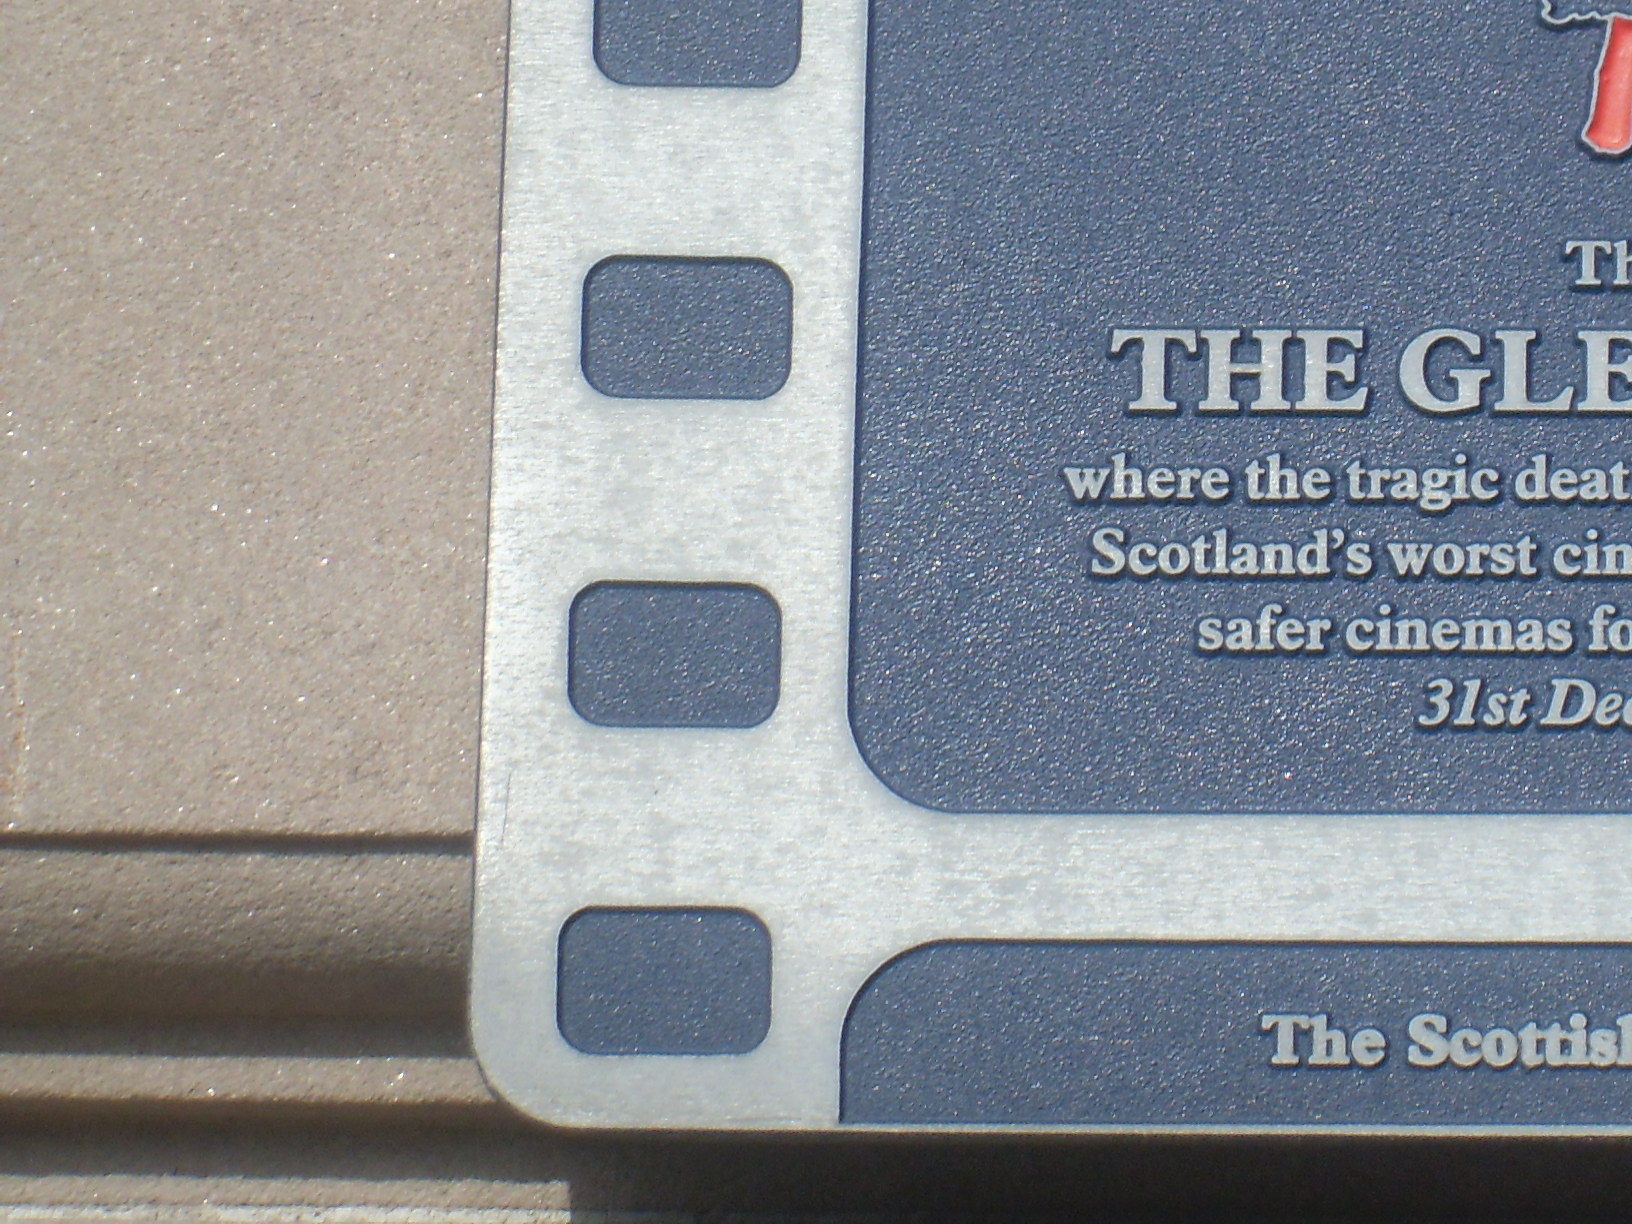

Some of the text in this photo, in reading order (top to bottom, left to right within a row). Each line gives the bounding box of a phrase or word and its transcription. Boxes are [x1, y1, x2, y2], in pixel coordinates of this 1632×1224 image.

[1110, 328, 1368, 413] THE
[1063, 452, 1231, 502] where
[1246, 452, 1332, 502] the
[1348, 453, 1500, 512] tragic
[1387, 536, 1538, 576] worst
[1197, 603, 1333, 652] safer
[1345, 603, 1573, 653] cinemas
[1418, 677, 1528, 728] 31st
[1261, 1013, 1386, 1068] The
